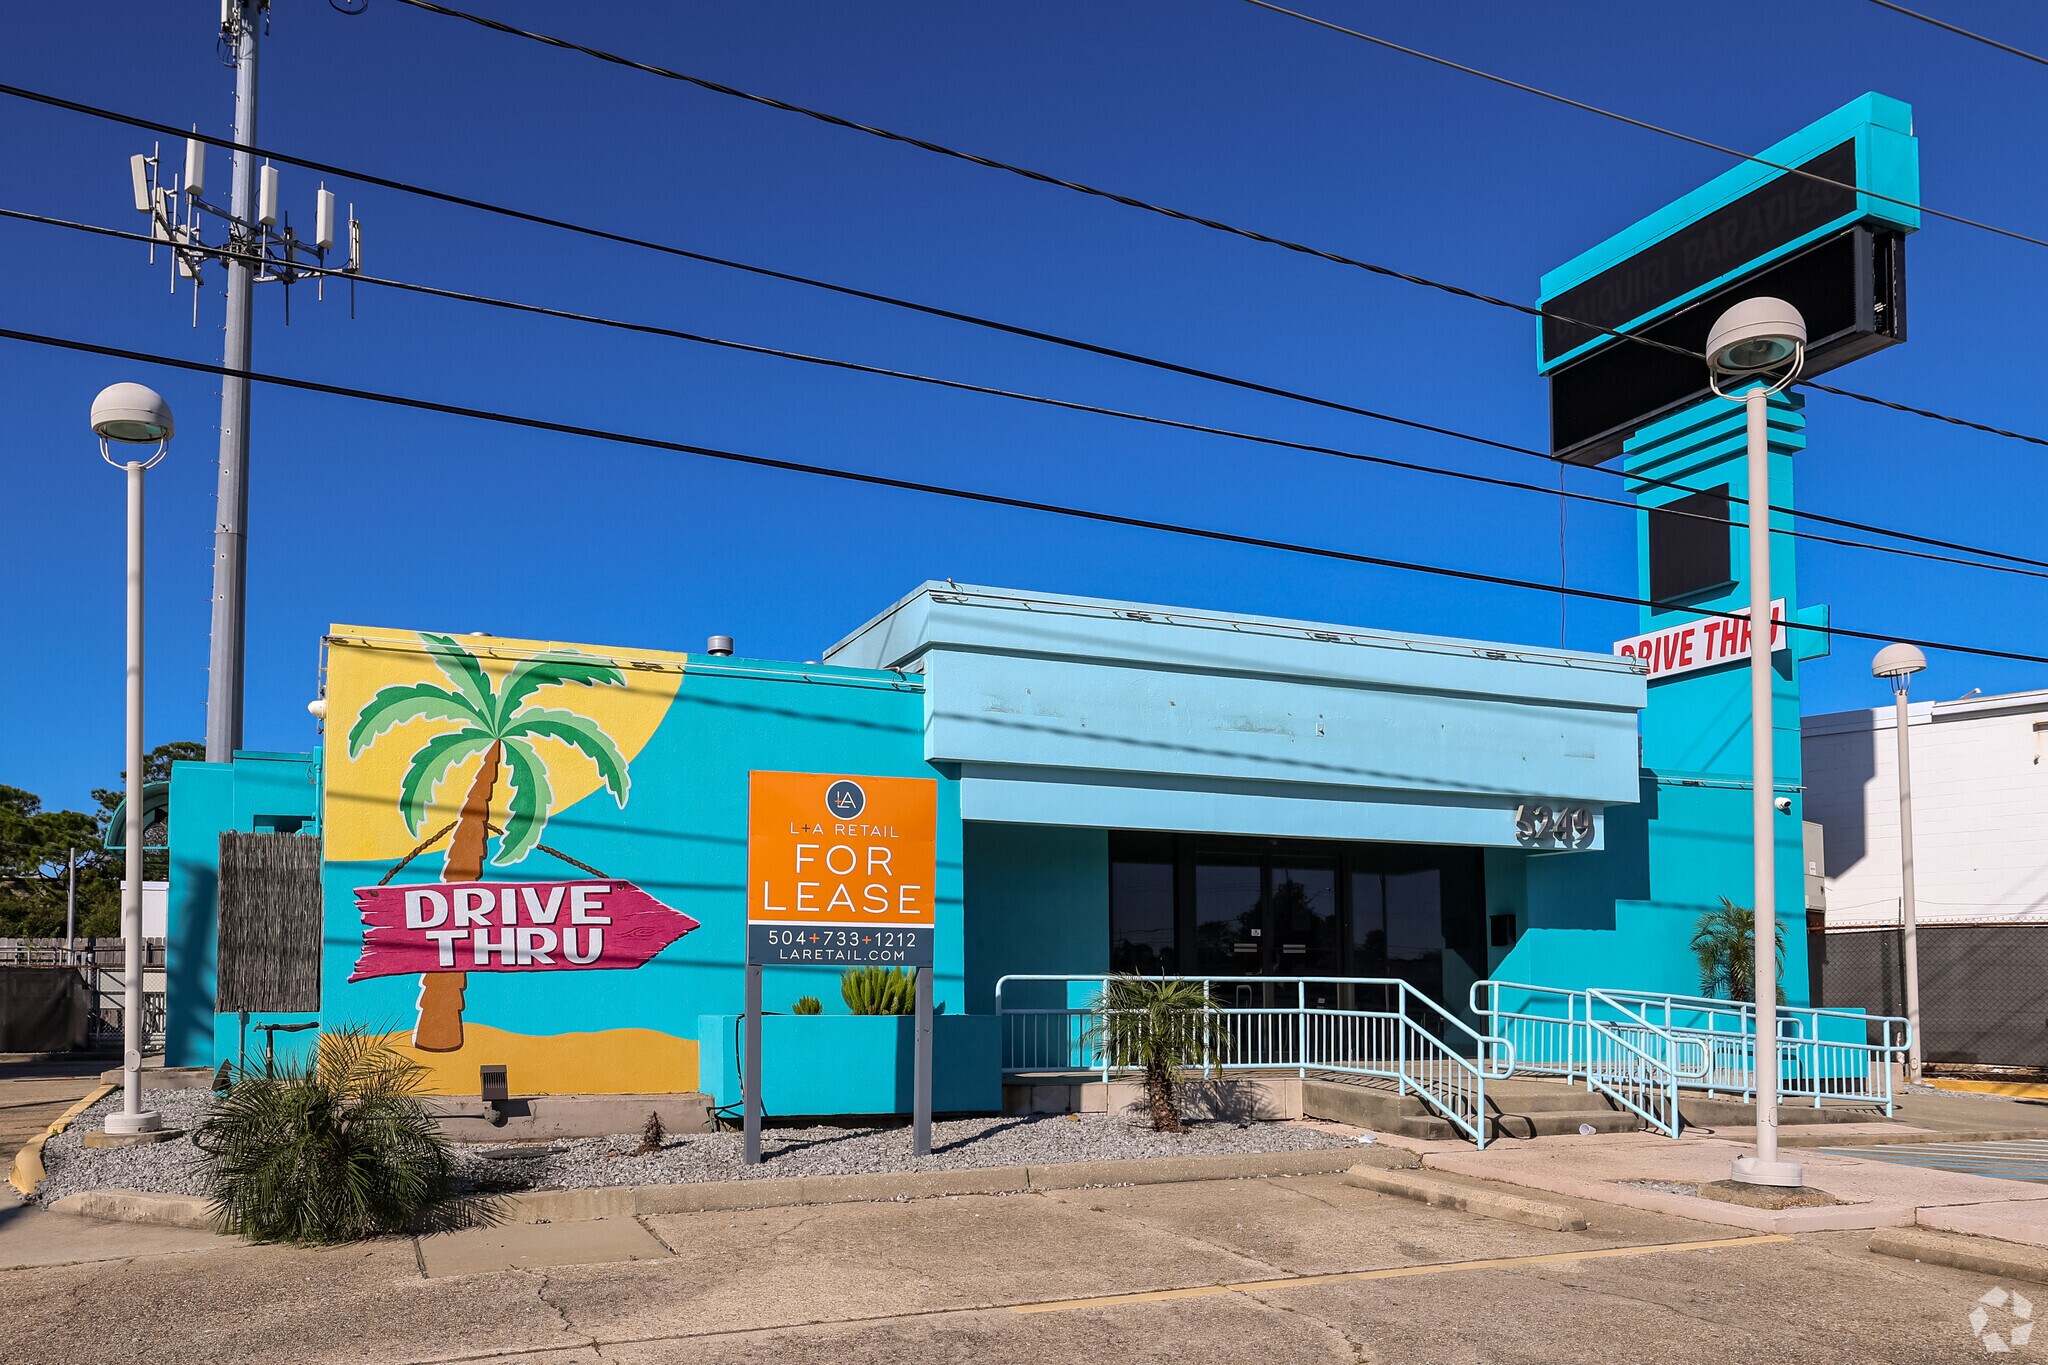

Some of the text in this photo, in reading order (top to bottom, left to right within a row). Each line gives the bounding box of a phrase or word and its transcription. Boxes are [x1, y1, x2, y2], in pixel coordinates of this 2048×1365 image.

[790, 821, 900, 838] L+A RETAIL
[1515, 804, 1591, 843] 5249
[795, 843, 893, 877] FOR
[404, 885, 612, 929] DRIVE
[763, 880, 921, 914] LEASE
[425, 927, 604, 967] THRU
[779, 948, 905, 961] LARETAIL.COM
